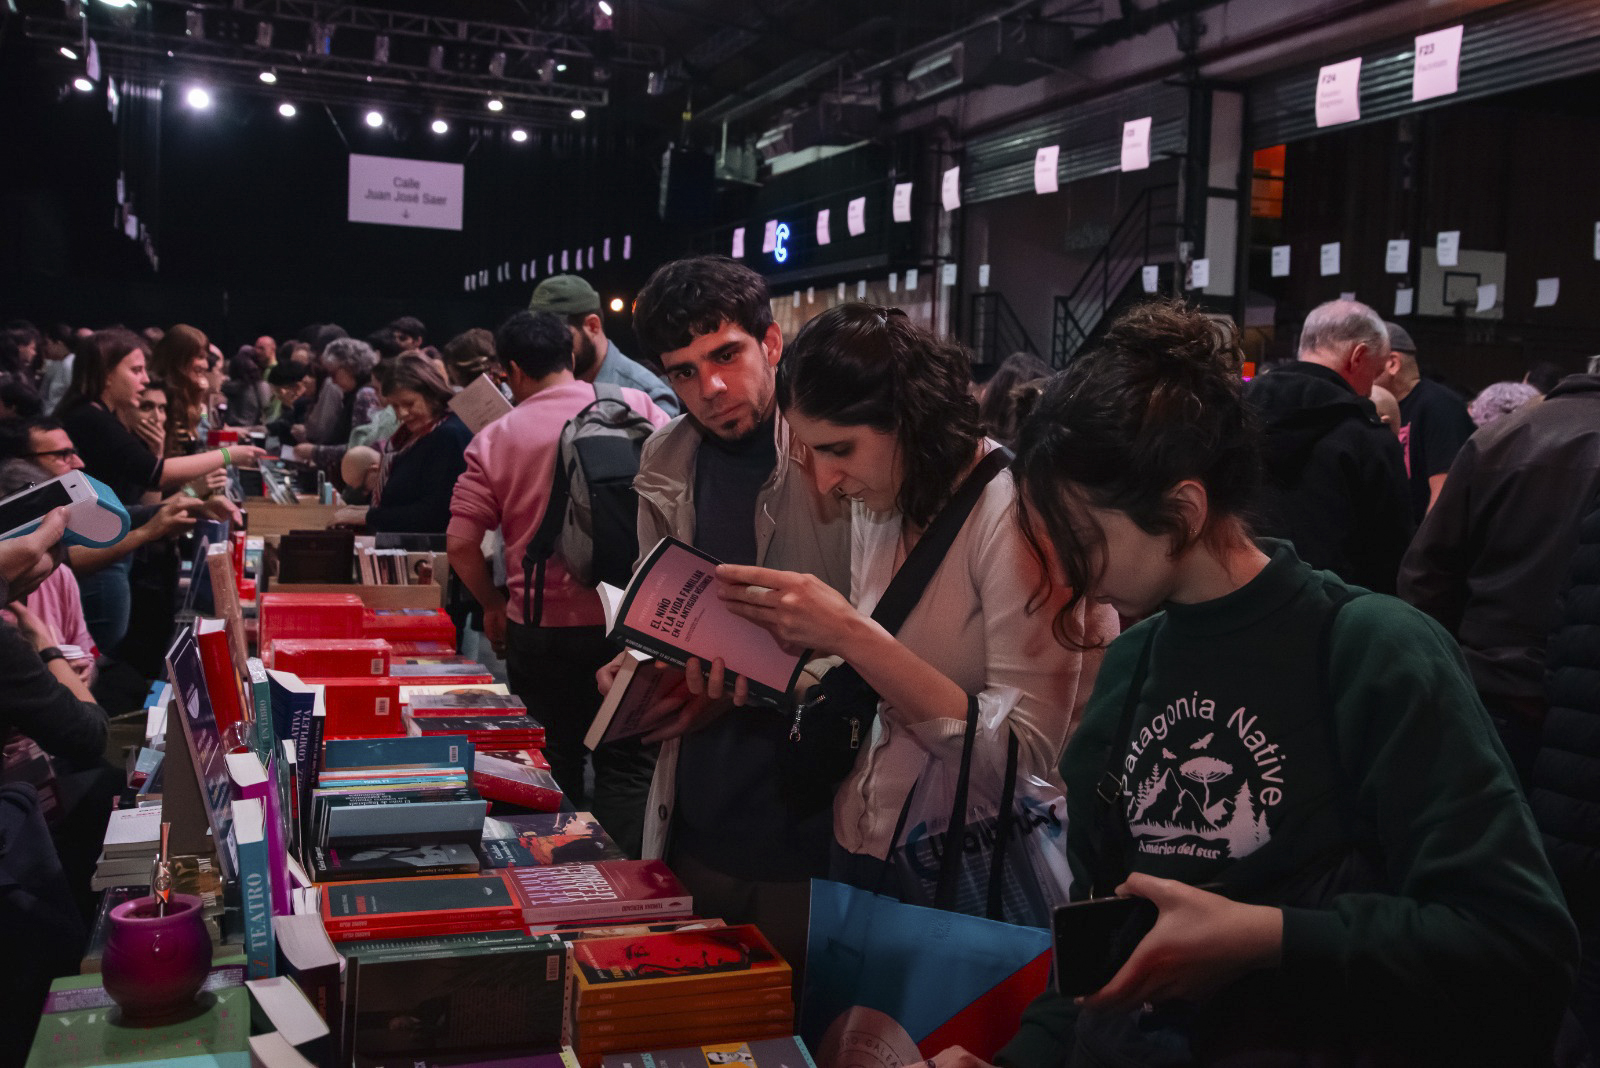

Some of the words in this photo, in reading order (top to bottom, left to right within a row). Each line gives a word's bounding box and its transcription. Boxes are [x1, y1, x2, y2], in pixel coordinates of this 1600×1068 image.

[1419, 44, 1435, 56] F23
[1321, 73, 1337, 85] F24
[393, 176, 420, 189] Calle
[364, 188, 391, 200] Juan
[394, 190, 419, 204] José
[422, 192, 448, 205] Saer
[664, 616, 676, 627] LA
[670, 597, 684, 616] VIDA
[680, 570, 706, 597] FAMILIAR
[680, 594, 698, 620] ANTIGUO
[655, 598, 672, 618] NIÑO
[650, 620, 662, 630] EL
[672, 628, 681, 638] EN
[676, 620, 685, 628] EL
[260, 700, 270, 729] LIBRO
[298, 710, 312, 762] COMPLETA
[1121, 690, 1216, 797] Patagonia
[1226, 706, 1286, 806] Native
[1177, 842, 1196, 856] del
[1196, 848, 1220, 860] sur
[246, 872, 268, 951] TEATRO
